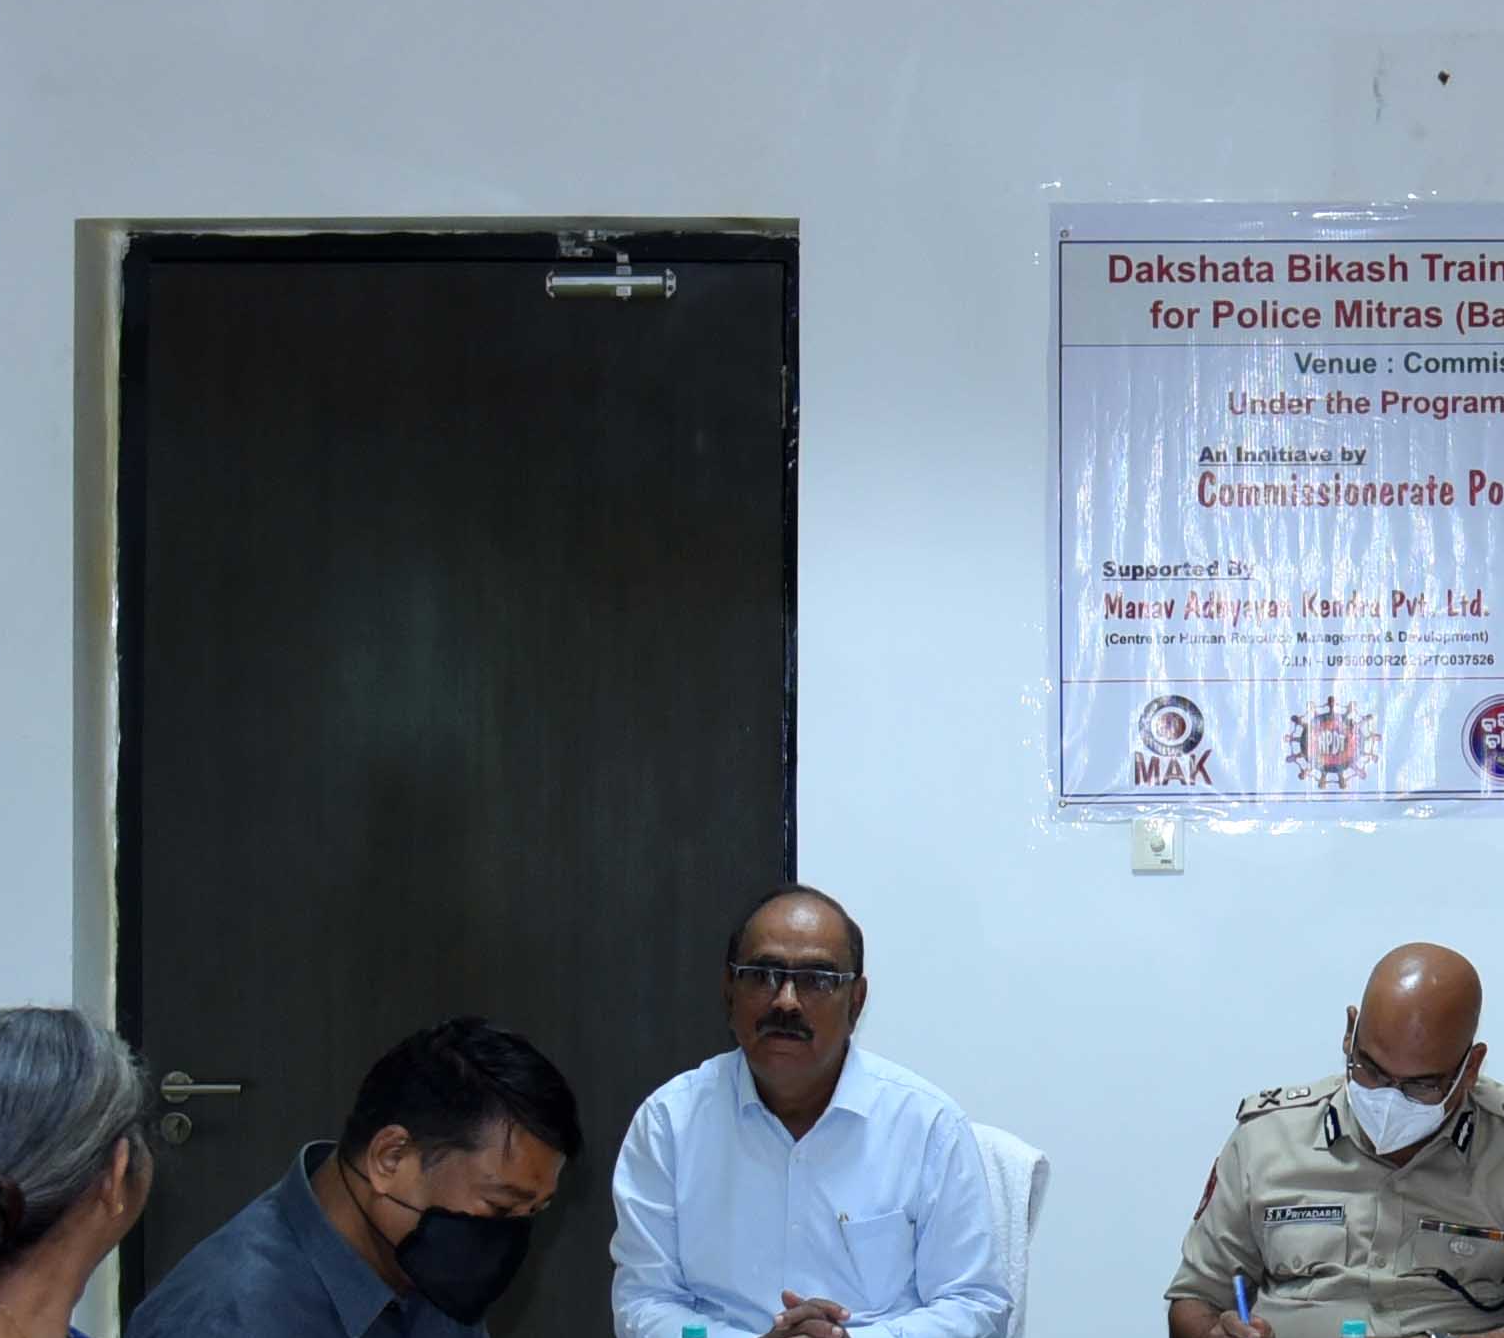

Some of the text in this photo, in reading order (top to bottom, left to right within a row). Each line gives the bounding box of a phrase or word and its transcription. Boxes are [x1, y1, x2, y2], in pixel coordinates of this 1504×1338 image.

[1109, 255, 1274, 284] Dakshata
[1287, 254, 1408, 283] Bikash
[1150, 300, 1200, 329] for
[1211, 300, 1321, 329] Police
[1334, 301, 1443, 328] Mitras
[1294, 352, 1378, 374] Venue
[1387, 357, 1394, 374] :
[1227, 391, 1315, 415] Under
[1325, 391, 1371, 414] the
[1199, 446, 1227, 462] An
[1341, 446, 1367, 465] by
[1197, 470, 1455, 508] Commissionerate
[1102, 561, 1255, 580] Supported By
[1104, 591, 1175, 620] Manav
[1301, 590, 1380, 620] Kendra
[1447, 589, 1490, 618] Ltd.
[1105, 632, 1153, 647] (Centre
[1384, 631, 1394, 643] &
[1134, 749, 1213, 786] MAK
